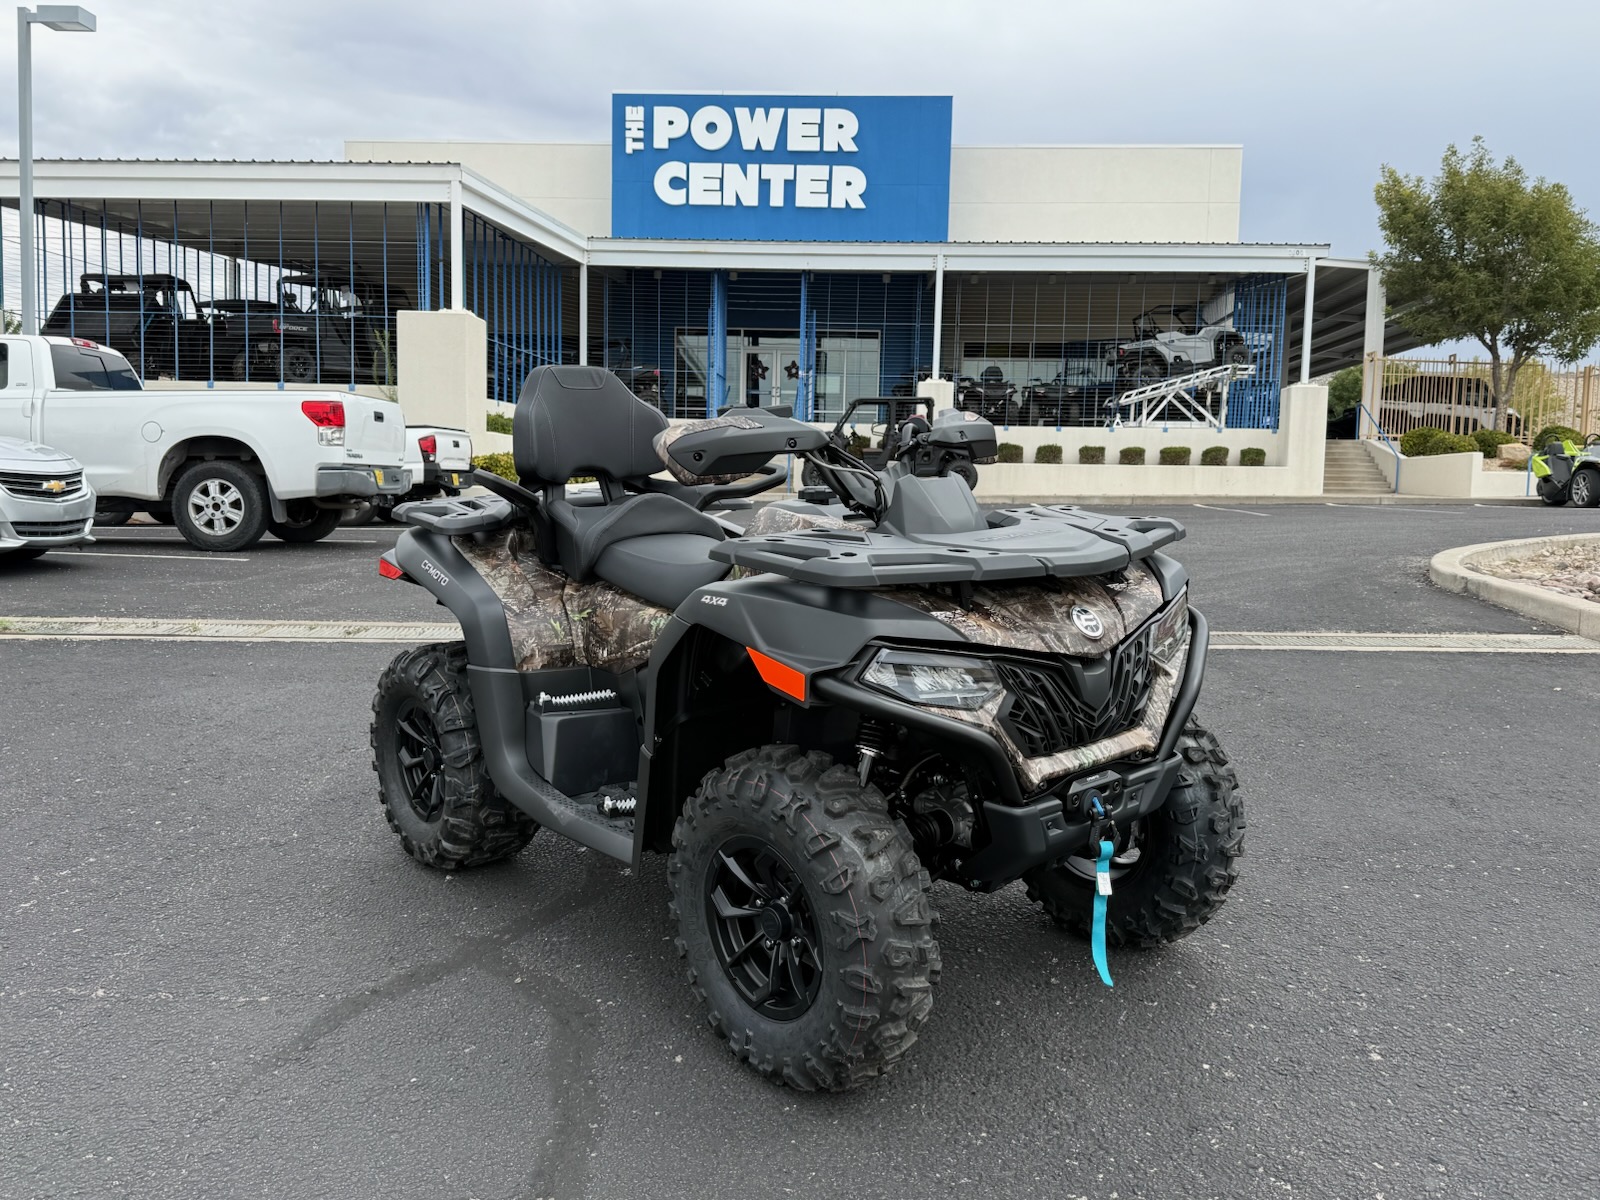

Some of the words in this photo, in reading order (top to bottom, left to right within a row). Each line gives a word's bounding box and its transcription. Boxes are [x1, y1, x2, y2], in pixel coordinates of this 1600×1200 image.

[625, 106, 645, 154] THE
[653, 105, 859, 152] POWER
[653, 161, 867, 209] CENTER
[421, 560, 449, 586] CFMOTO
